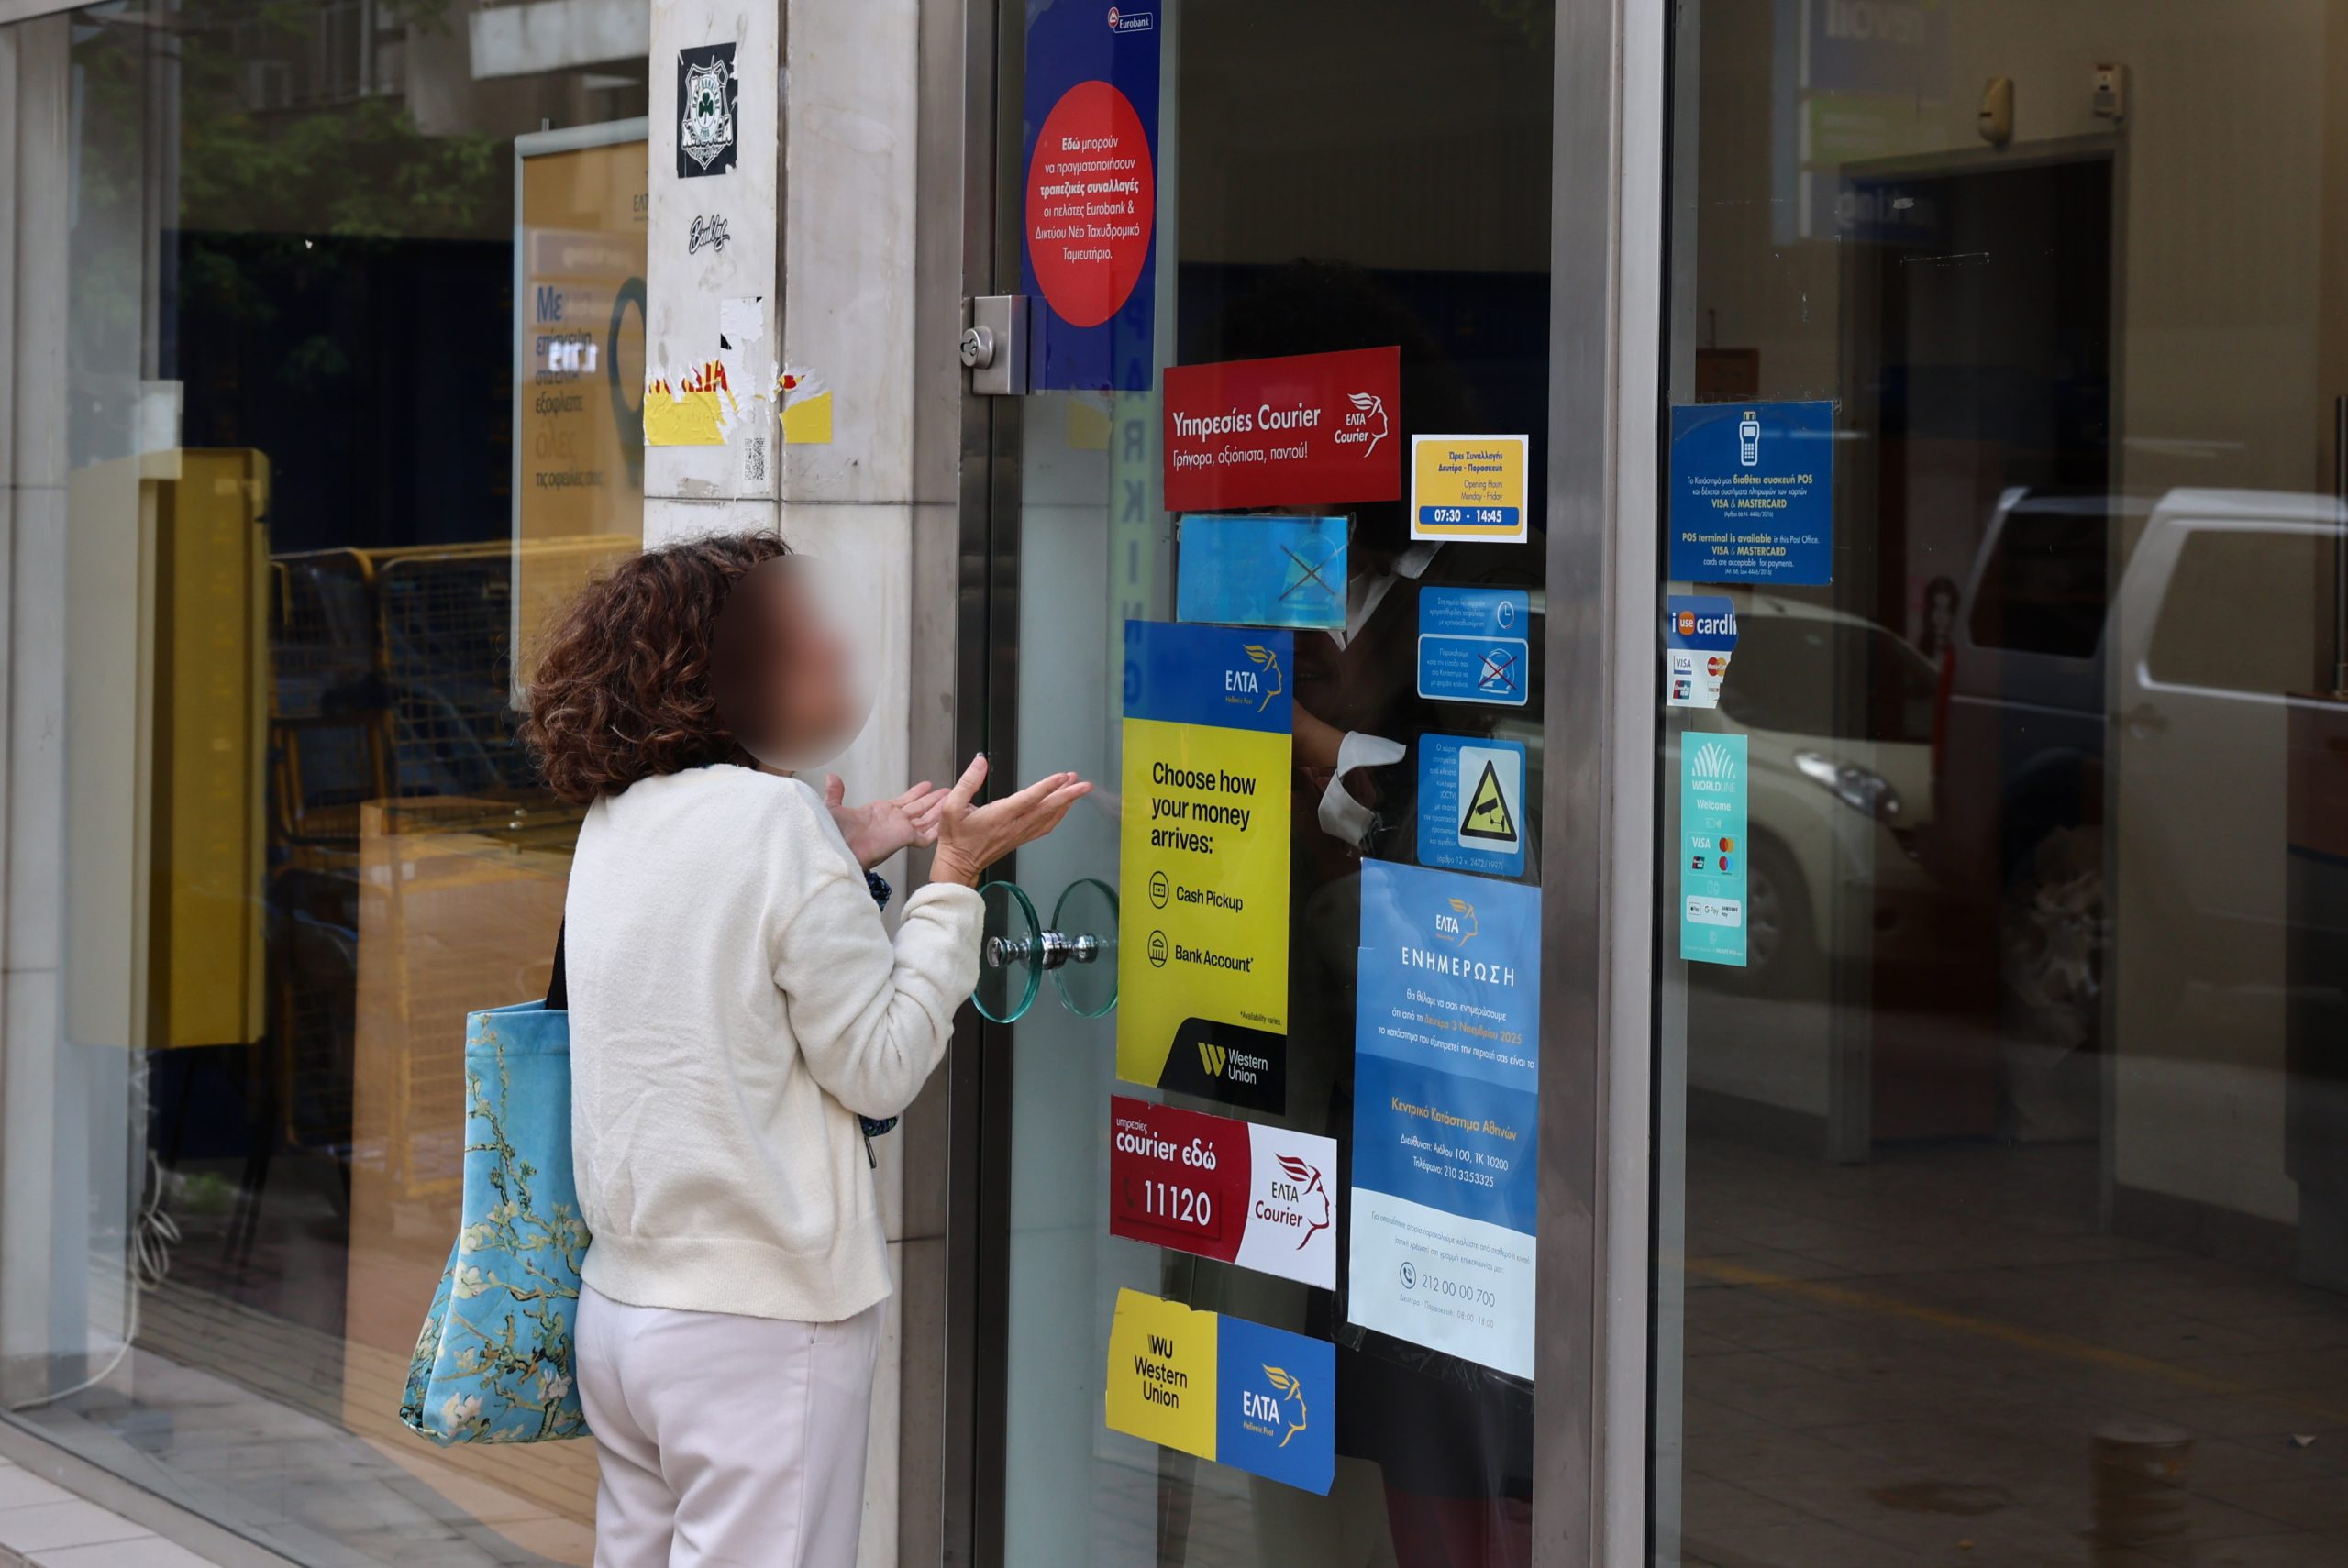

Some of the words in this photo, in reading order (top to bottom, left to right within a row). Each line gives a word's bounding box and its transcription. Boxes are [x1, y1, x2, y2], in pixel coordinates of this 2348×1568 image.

[1120, 17, 1149, 28] Eurobank
[1062, 137, 1080, 151] Εδώ
[1082, 135, 1118, 153] μπορούν
[1046, 164, 1054, 173] να
[1057, 157, 1135, 176] πραγματοποιήσουν
[1040, 181, 1084, 199] τραπεζικές
[1087, 178, 1138, 194] συναλλαγές
[633, 194, 648, 213] ΕΛΤ
[1044, 207, 1051, 217] οι
[1054, 204, 1084, 218] πελάτες
[1087, 201, 1125, 215] Eurobank
[1128, 200, 1134, 214] &
[1036, 226, 1066, 238] Δικτύου
[1069, 225, 1084, 237] Νέο
[1087, 223, 1139, 240] Ταχυδρομικό
[1063, 247, 1113, 263] Ταμιευτήριο.
[537, 286, 562, 323] Με
[1173, 407, 1252, 442] Υπηρεσίες
[1258, 403, 1321, 430] Courier
[1346, 413, 1366, 426] ΕΛΤΑ
[1335, 429, 1368, 444] Courier
[1173, 449, 1214, 471] Γρήγορα,
[1218, 445, 1267, 466] αξιόπιστα,
[1270, 441, 1308, 460] παντού!
[1467, 450, 1502, 461] Συναλλαγής
[1438, 464, 1462, 474] Δευτέρα
[1468, 464, 1502, 474] Παρασκευή
[1464, 480, 1486, 490] Opening
[1688, 476, 1693, 485] Το
[1733, 474, 1761, 484] διαθέτει
[1763, 475, 1795, 484] συσκευή
[1798, 475, 1813, 483] POS
[1461, 492, 1482, 502] Monday
[1487, 492, 1502, 502] Friday
[1749, 487, 1776, 497] πληρωμών
[1789, 487, 1807, 498] καρτών
[1712, 499, 1729, 508] VISA
[1731, 500, 1735, 508] &
[1738, 499, 1787, 509] MASTERCARD
[1434, 509, 1461, 522] 07:30
[1477, 510, 1501, 523] 14:45
[1682, 533, 1696, 542] POS
[1699, 533, 1727, 542] terminal
[1730, 534, 1735, 543] is
[1738, 533, 1771, 544] available
[1780, 536, 1789, 544] this
[1712, 547, 1729, 555] VISA
[1738, 547, 1786, 556] MASTERCARD
[1729, 558, 1756, 568] acceptable
[1768, 559, 1794, 568] payments.
[1672, 613, 1676, 633] i
[1680, 619, 1693, 627] use
[1676, 658, 1690, 668] VISA
[1225, 670, 1258, 693] ΕΛΤΑ
[1225, 696, 1242, 704] Hellenic
[1153, 762, 1215, 791] Choose
[1220, 770, 1256, 796] how
[1692, 779, 1735, 792] WORLDLINE
[1697, 799, 1731, 811] Welcome
[1152, 798, 1188, 820] your
[1192, 802, 1250, 832] money
[1151, 827, 1213, 855] arrives:
[1692, 837, 1711, 849] VISA
[1177, 886, 1203, 904] Cash
[1207, 891, 1243, 913] Pickup
[1711, 906, 1719, 915] Pay
[1436, 914, 1458, 933] ΕΛΤΑ
[1176, 945, 1202, 964] Bank
[1402, 946, 1514, 987] ΕΝΗΜΕΡΩΣΗ
[1407, 988, 1415, 1000] θα
[1417, 990, 1436, 1007] θέλαμε
[1437, 999, 1445, 1008] να
[1445, 1001, 1457, 1011] σας
[1460, 1004, 1507, 1021] ενημερώσουμε
[1392, 1007, 1401, 1018] ότι
[1402, 1010, 1414, 1021] από
[1417, 1014, 1423, 1023] τη
[1453, 1020, 1457, 1031] 3
[1460, 1021, 1498, 1040] Νοεμβρίου
[1501, 1030, 1523, 1044] 2025
[1387, 1027, 1418, 1043] κατάστημα
[1420, 1034, 1429, 1044] που
[1461, 1043, 1471, 1054] την
[1472, 1045, 1495, 1061] περιοχή
[1497, 1053, 1508, 1064] σας
[1510, 1053, 1526, 1067] είναι
[1527, 1060, 1534, 1069] το
[1229, 1048, 1268, 1071] Western
[1228, 1065, 1257, 1085] Union
[1116, 1118, 1147, 1135] υπηρεσίες
[1391, 1097, 1429, 1118] Κεντρικό
[1431, 1107, 1479, 1132] Κατάστημα
[1482, 1121, 1517, 1142] Αθηνών
[1116, 1132, 1177, 1162] courier
[1182, 1138, 1216, 1171] εδώ
[1434, 1142, 1453, 1158] Αιόλου
[1455, 1148, 1472, 1164] 100,
[1487, 1154, 1509, 1172] 10200
[1413, 1156, 1443, 1174] Τηλέφωνο:
[1444, 1165, 1456, 1179] 210
[1458, 1169, 1494, 1187] 3353325
[1272, 1182, 1299, 1203] ΕΛΤΑ
[1145, 1180, 1211, 1226] 11120
[1256, 1200, 1303, 1228] Courier
[1456, 1237, 1479, 1250] καλέστε
[1422, 1275, 1438, 1292] 212
[1442, 1280, 1456, 1296] 00
[1459, 1284, 1473, 1300] 00
[1476, 1289, 1495, 1307] 700
[1400, 1294, 1420, 1306] Δευτέρα
[1456, 1310, 1473, 1322] 08:00
[1147, 1334, 1173, 1359] WU
[1135, 1355, 1188, 1389] Western
[1143, 1381, 1179, 1409] Union
[1243, 1391, 1280, 1425] ΕΛΤΑ
[1243, 1421, 1263, 1435] Hellenic
[1263, 1428, 1274, 1437] Post
